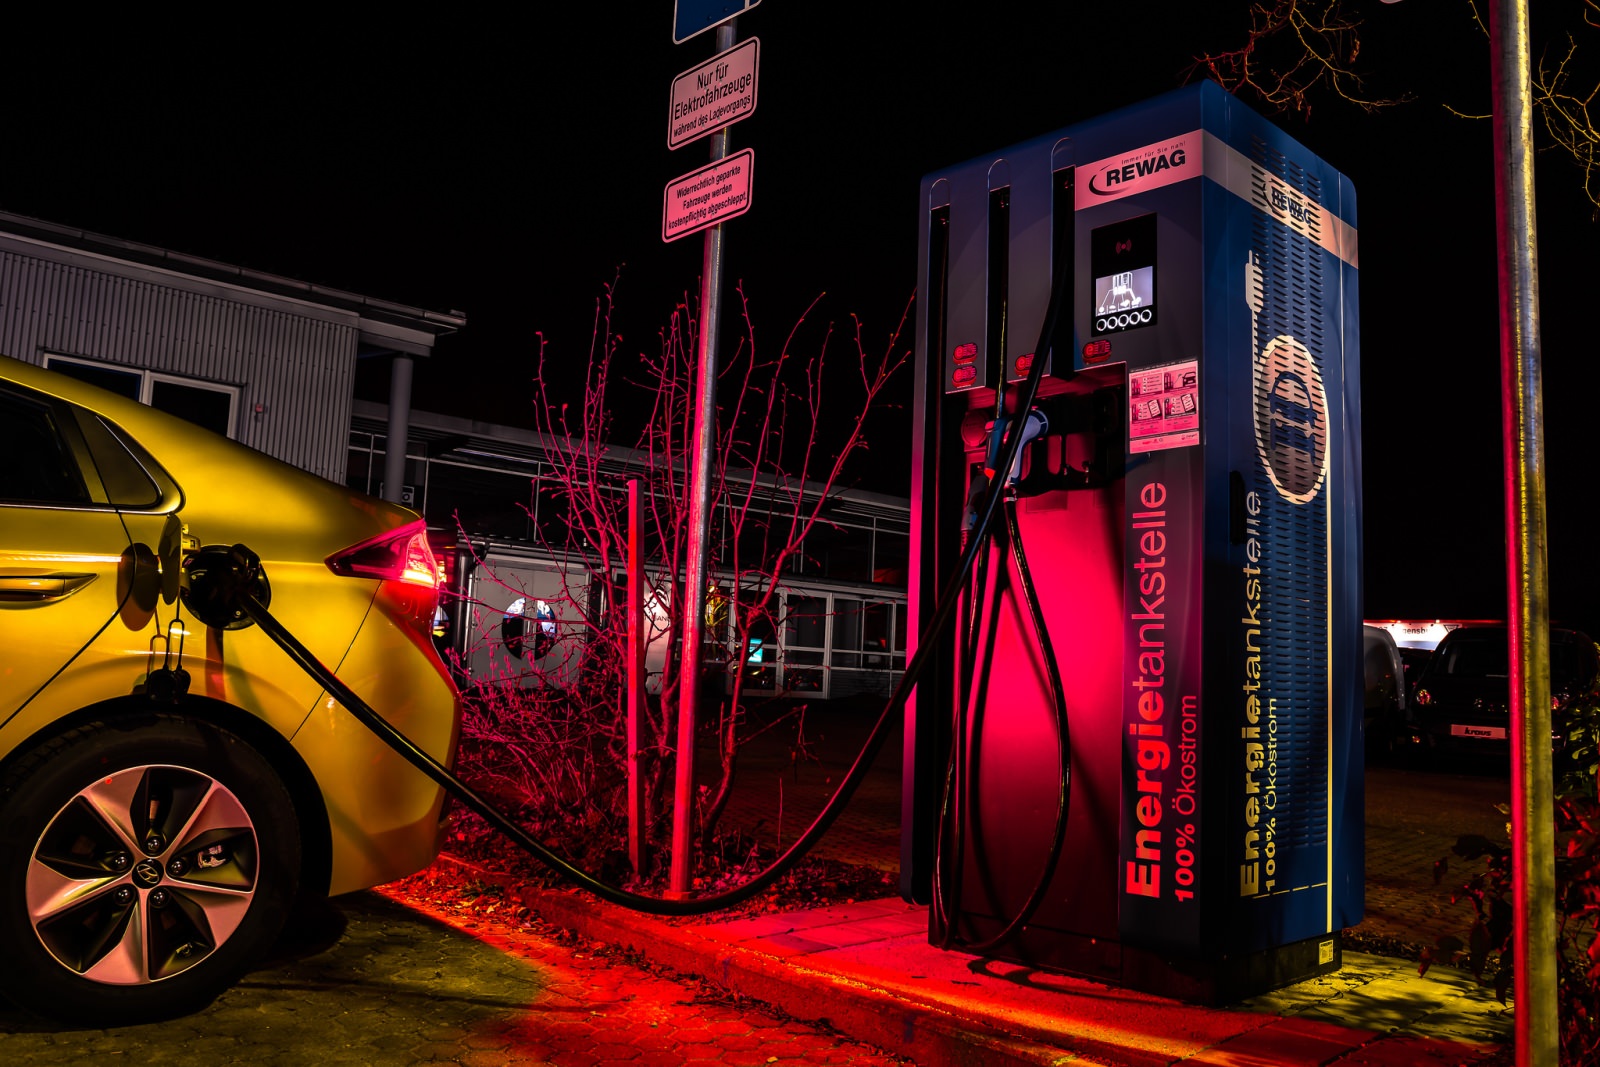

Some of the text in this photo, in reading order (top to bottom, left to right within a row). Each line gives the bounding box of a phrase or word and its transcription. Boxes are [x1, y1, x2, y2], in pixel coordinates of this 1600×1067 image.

[697, 62, 728, 89] Nur für
[673, 94, 751, 137] während des Ladevorgangs
[675, 73, 752, 120] Elektrofahrzeuge
[1106, 149, 1186, 187] REWAG
[1121, 140, 1186, 165] Immer für Sie nah!
[677, 165, 741, 199] Widerrechtlich geparkte
[682, 183, 732, 210] Fahrzeuge werden
[668, 207, 706, 229] kostenpflichtig
[1126, 481, 1170, 899] Energietankstelle
[1239, 490, 1265, 899] Energietankstelle
[1172, 695, 1197, 903] 100% Ökostrom
[1263, 697, 1278, 893] 100% Ökostrom
